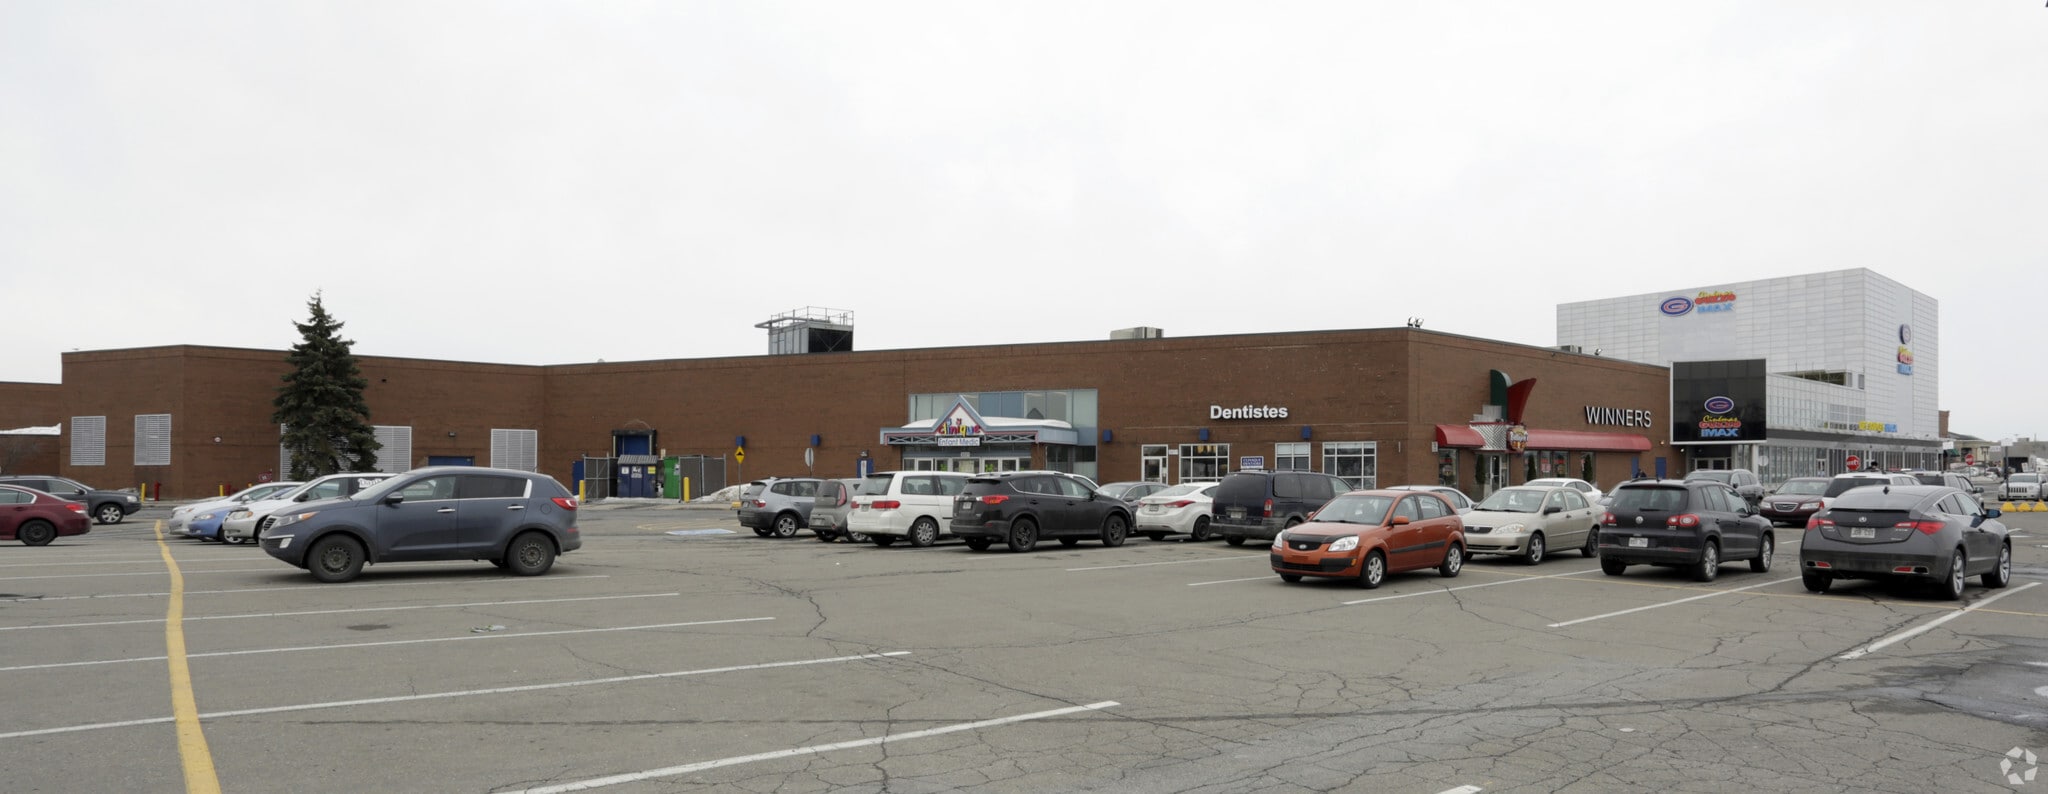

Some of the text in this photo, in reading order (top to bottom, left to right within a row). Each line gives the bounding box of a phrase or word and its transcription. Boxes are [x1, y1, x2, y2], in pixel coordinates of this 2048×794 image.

[1210, 405, 1288, 419] Dentistes
[1585, 405, 1652, 428] WINNERS
[938, 418, 981, 438] clinique
[1701, 428, 1739, 437] IMAX
